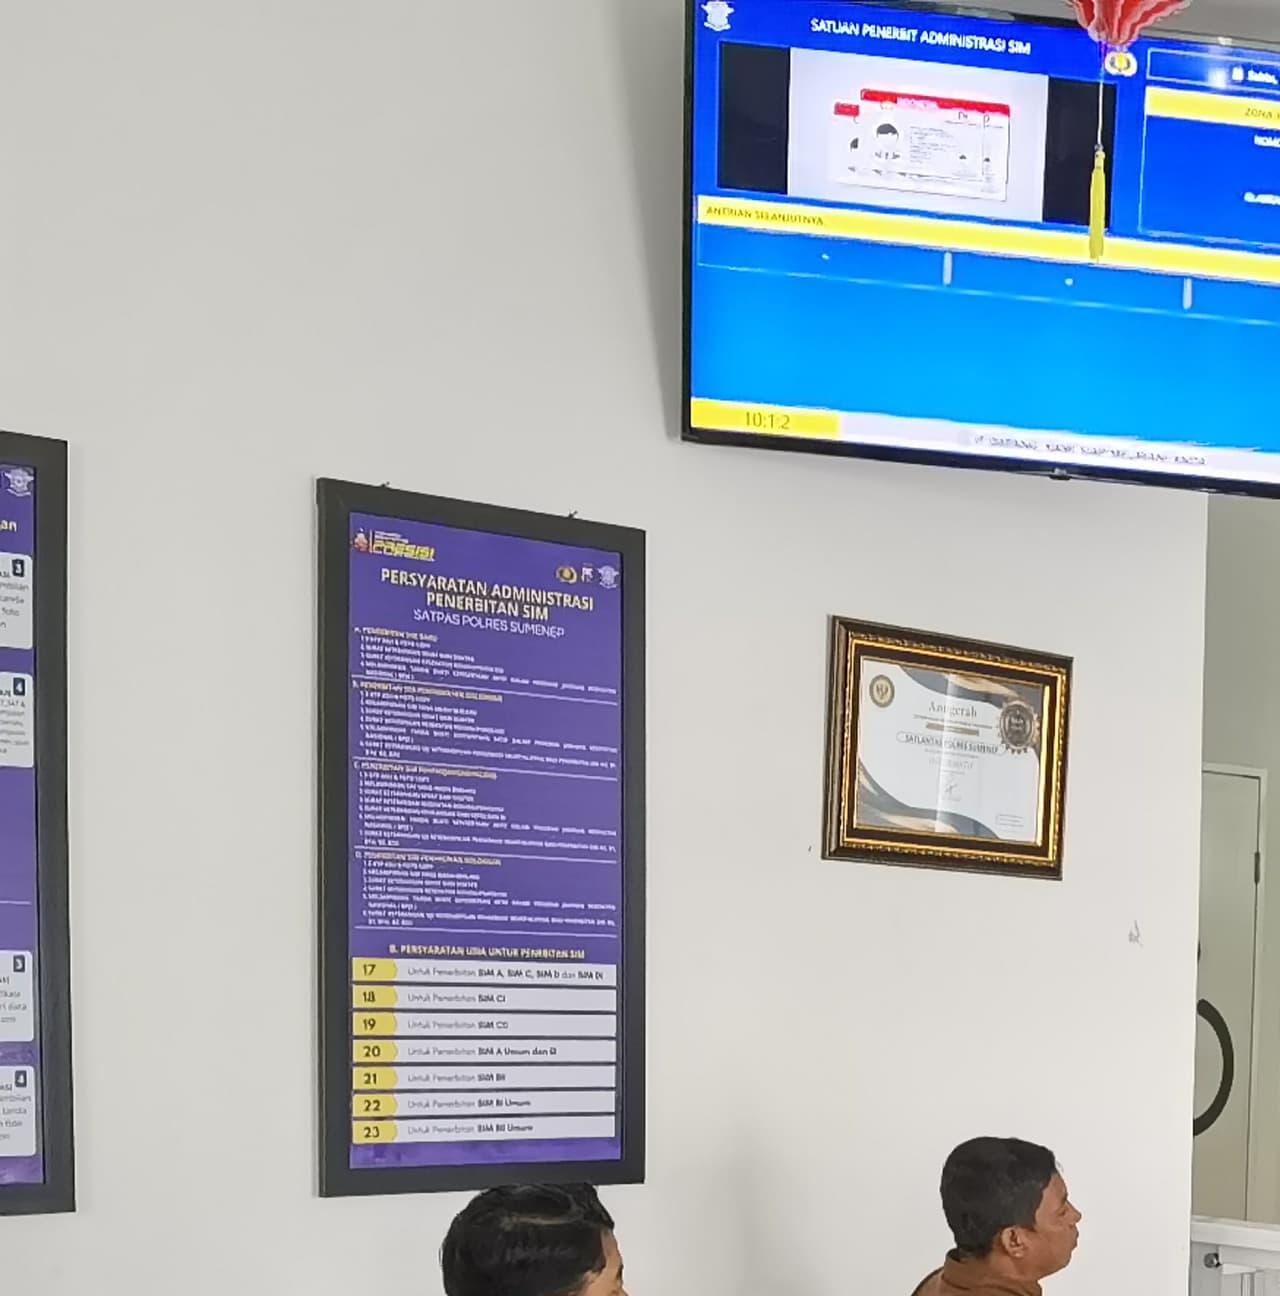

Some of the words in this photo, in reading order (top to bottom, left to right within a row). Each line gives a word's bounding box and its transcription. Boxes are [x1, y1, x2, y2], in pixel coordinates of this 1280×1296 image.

[811, 18, 860, 36] SATUAN
[920, 31, 1006, 52] ADMINISTRASI
[1007, 39, 1031, 55] SIM
[381, 568, 487, 596] PERSYARATAN
[491, 585, 594, 611] ADMINISTRASI
[427, 592, 519, 617] PENERBITAN
[522, 605, 549, 621] SIM
[414, 608, 460, 627] SATPAS
[462, 616, 508, 632] POLRES
[510, 622, 565, 638] SUMENEP
[928, 701, 977, 718] Angerah
[400, 944, 465, 956] PERSYARATAN
[363, 964, 377, 976] 17
[363, 1018, 377, 1030] 19
[363, 1045, 381, 1057] 20
[363, 1073, 377, 1084] 21
[363, 1100, 381, 1112] 22
[363, 1126, 380, 1138] 23
